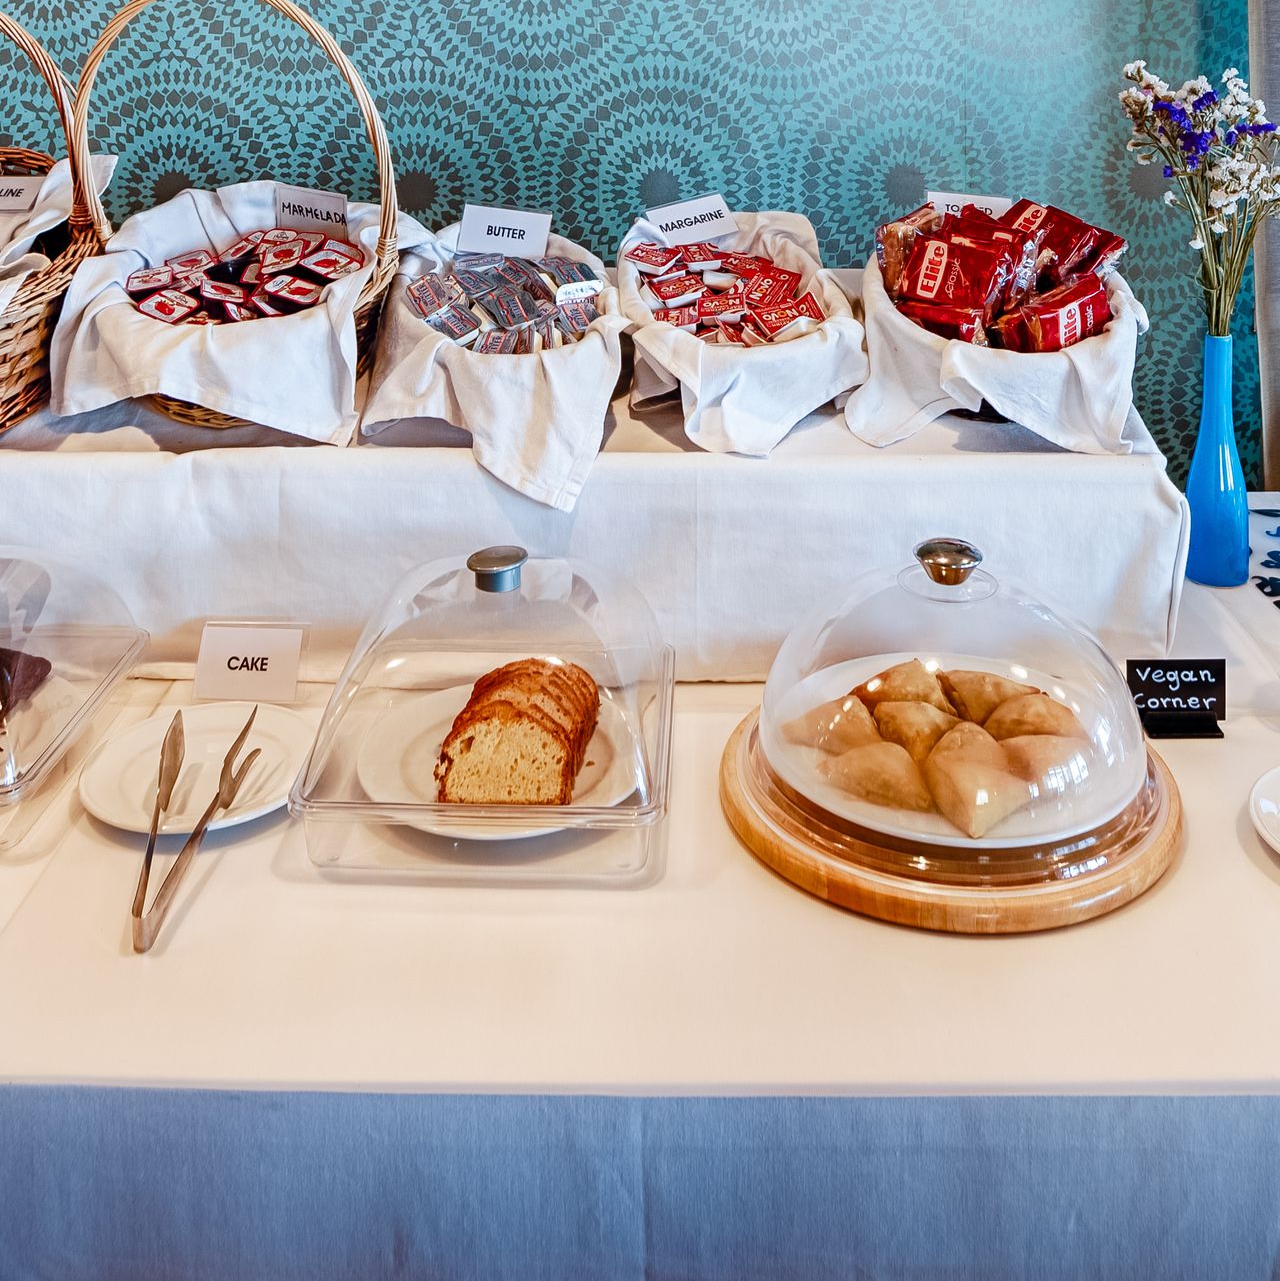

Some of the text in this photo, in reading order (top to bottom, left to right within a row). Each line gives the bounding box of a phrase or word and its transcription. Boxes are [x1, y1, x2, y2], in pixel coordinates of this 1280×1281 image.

[282, 201, 347, 227] MARMELADA
[658, 209, 725, 233] MARGARINE
[486, 224, 526, 240] BUTTER
[920, 244, 946, 294] Elite
[227, 656, 269, 671] CAKE
[1135, 666, 1216, 691] Vegan
[1133, 693, 1217, 710] Corner
